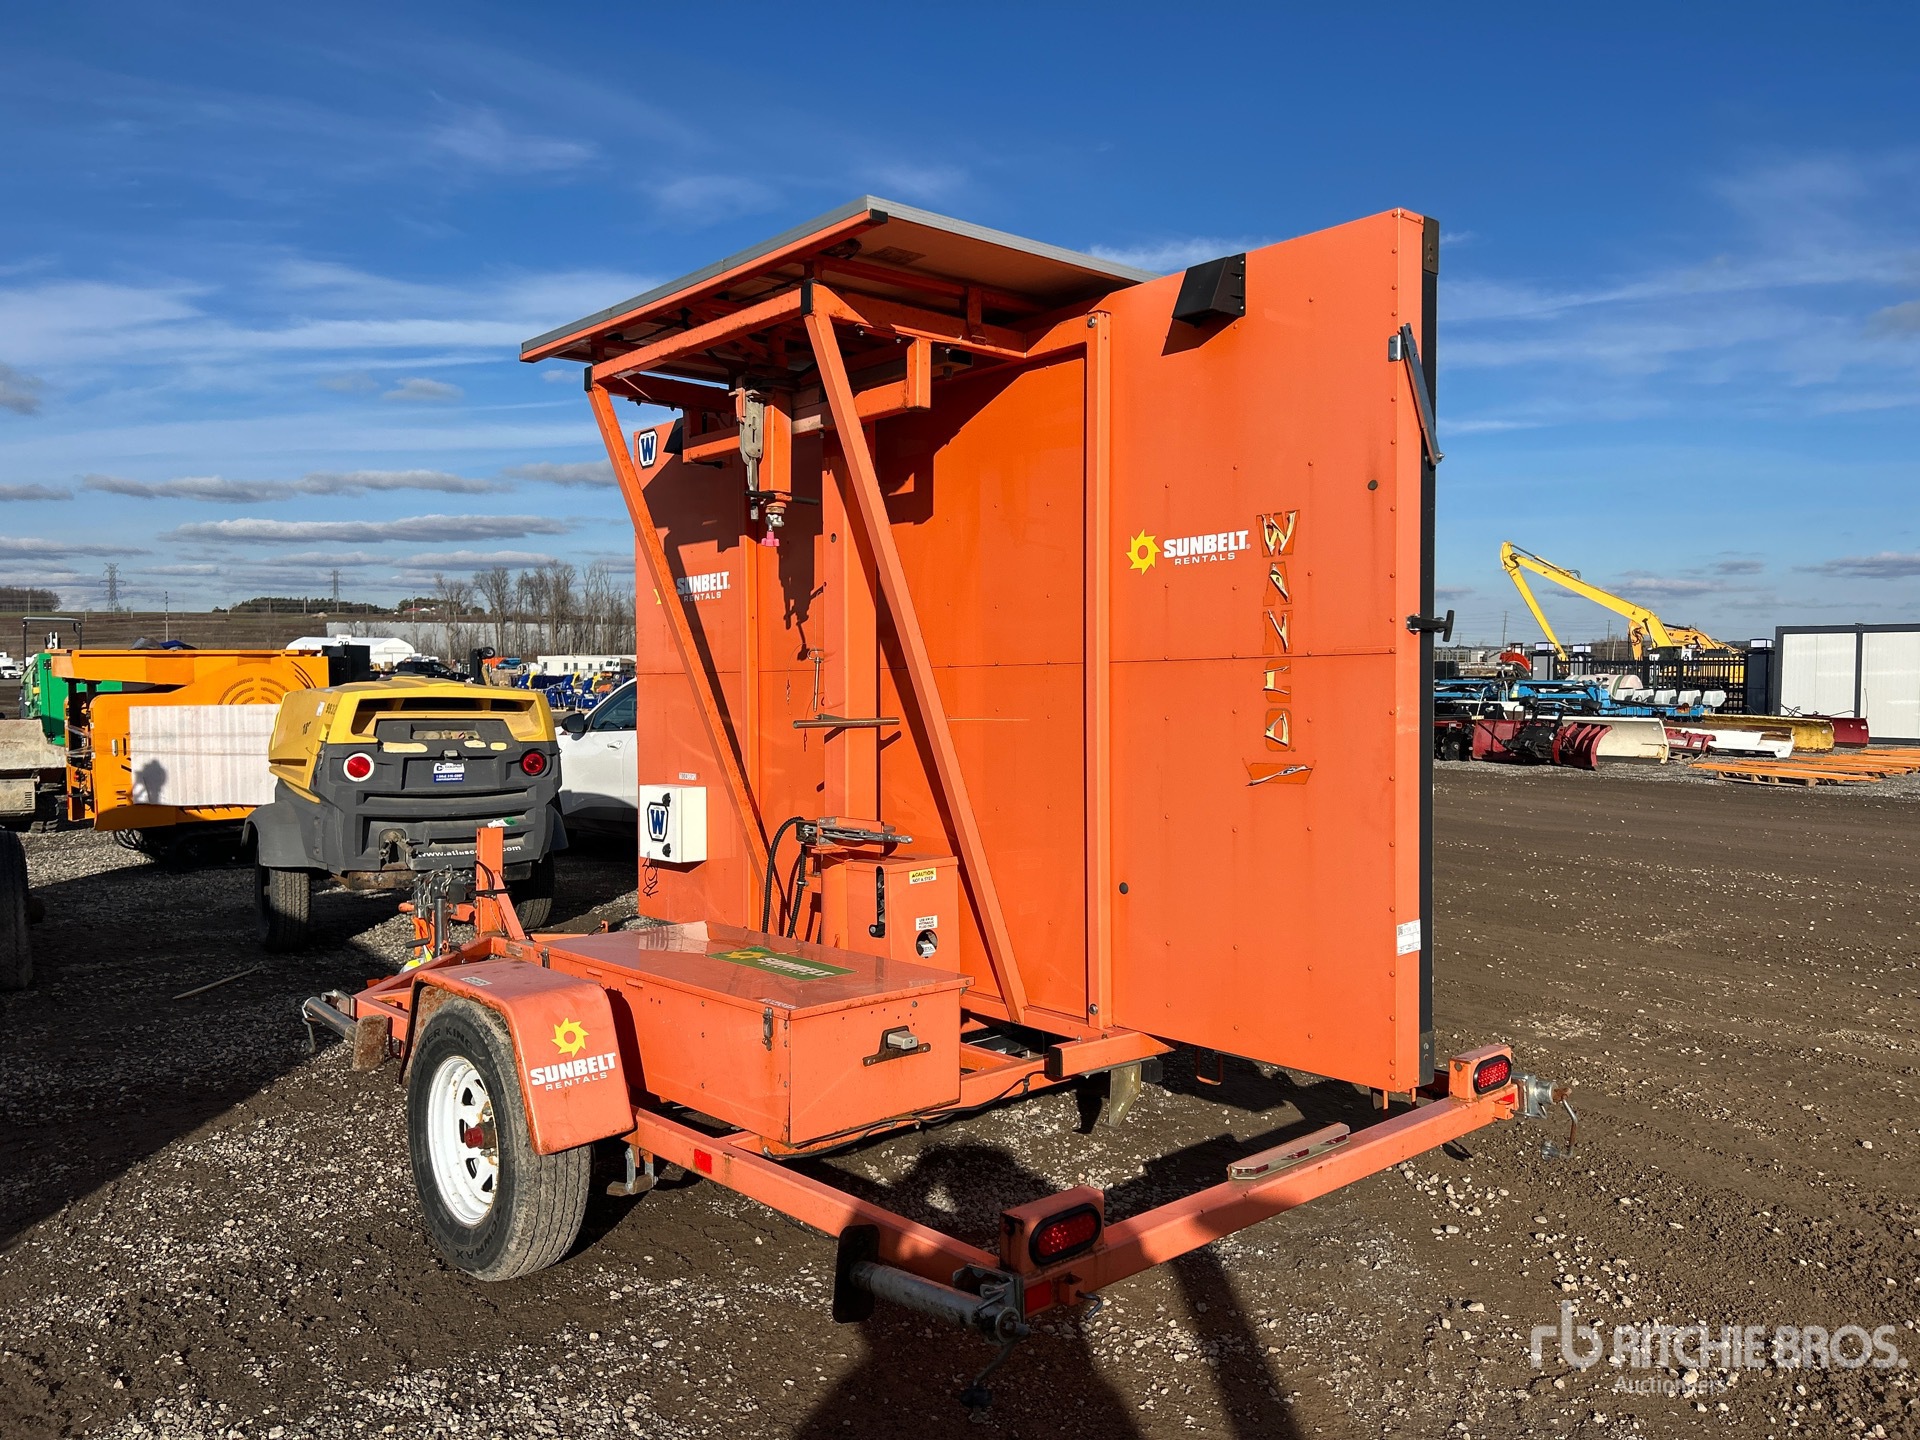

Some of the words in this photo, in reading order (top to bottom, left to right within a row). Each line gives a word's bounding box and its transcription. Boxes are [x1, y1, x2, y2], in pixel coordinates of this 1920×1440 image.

[1163, 529, 1249, 558] SUNBELT
[1174, 552, 1236, 566] RENTALS
[676, 571, 730, 595] SUNBELT
[683, 591, 722, 602] RENTALS
[757, 957, 836, 976] SUNBELT
[445, 1026, 473, 1050] KING
[530, 1052, 617, 1086] SUNBELT
[545, 1071, 608, 1091] RENTALS
